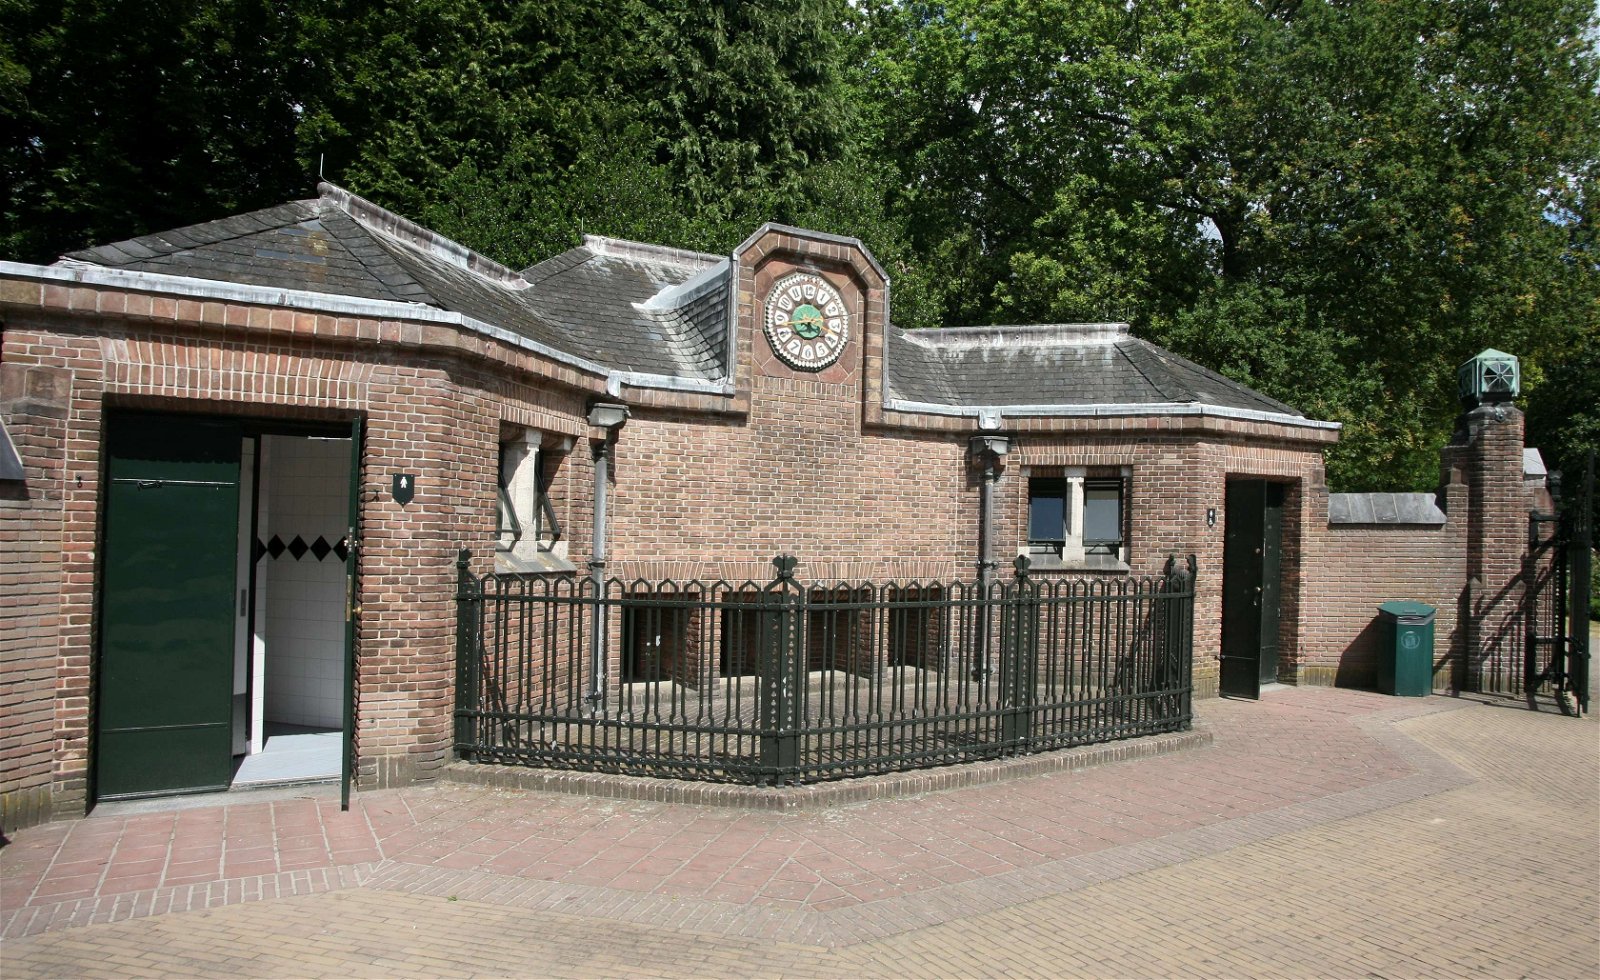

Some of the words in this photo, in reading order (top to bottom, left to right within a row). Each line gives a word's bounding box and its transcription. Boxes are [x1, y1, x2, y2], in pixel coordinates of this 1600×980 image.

[792, 287, 800, 298] 11
[805, 286, 814, 297] 12
[819, 292, 826, 301] 1
[780, 298, 790, 308] 10
[791, 342, 799, 351] 7
[818, 345, 825, 355] 5
[805, 348, 812, 358] 6
